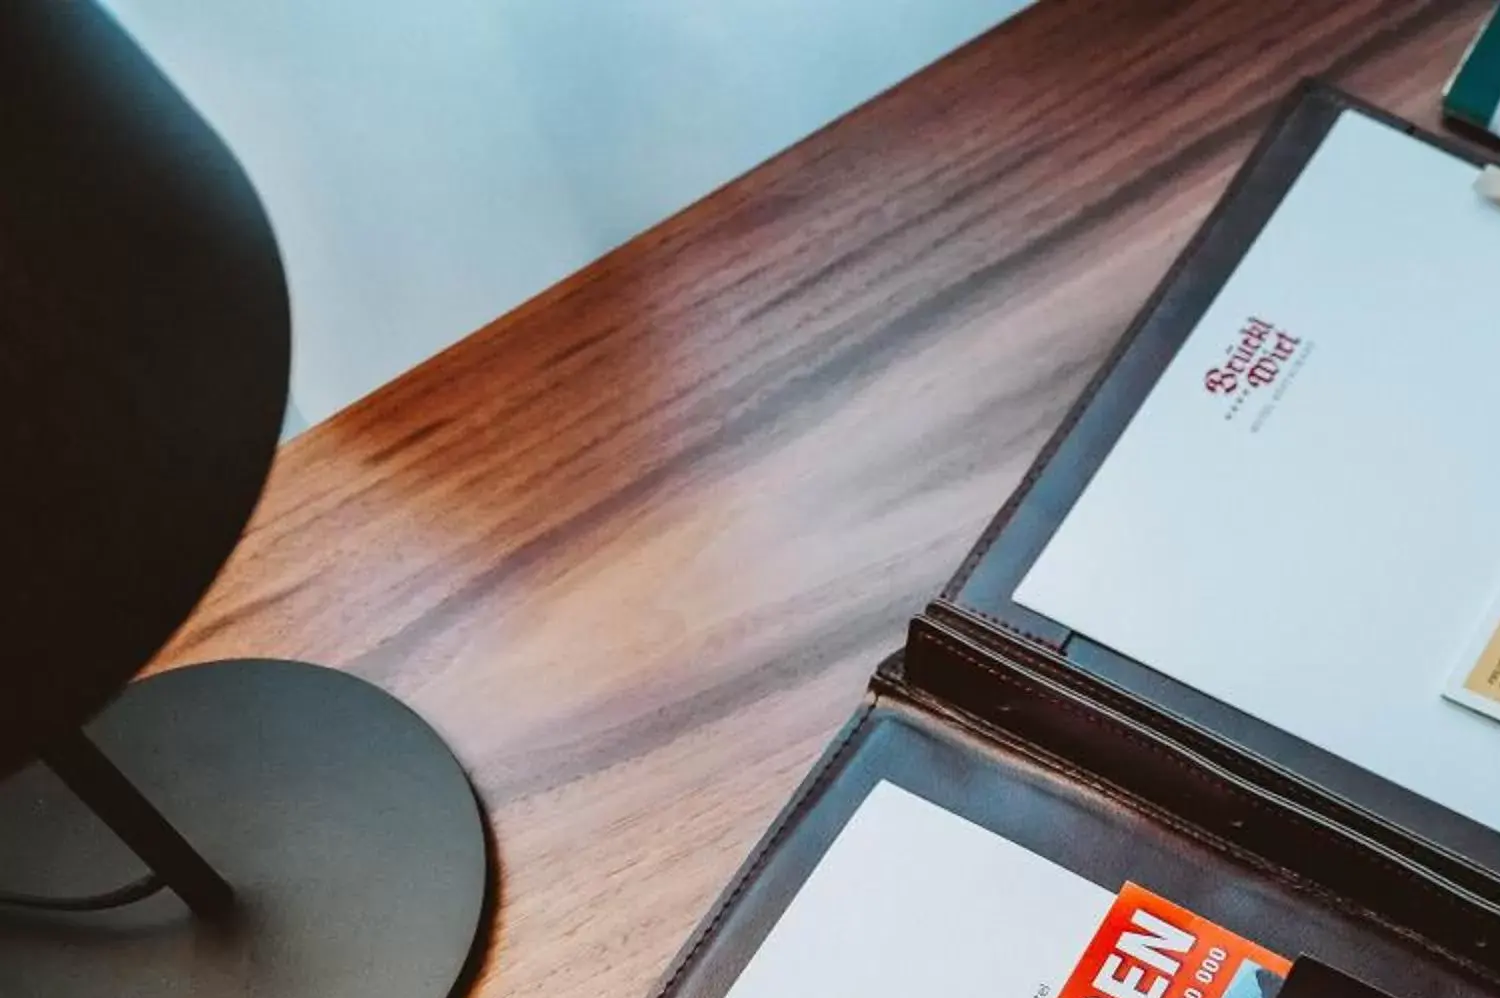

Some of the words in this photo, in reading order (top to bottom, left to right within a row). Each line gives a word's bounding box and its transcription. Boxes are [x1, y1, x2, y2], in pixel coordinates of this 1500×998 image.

[1205, 316, 1275, 392] Brückl
[1247, 332, 1301, 387] Wirt
[1195, 946, 1228, 984] 000
